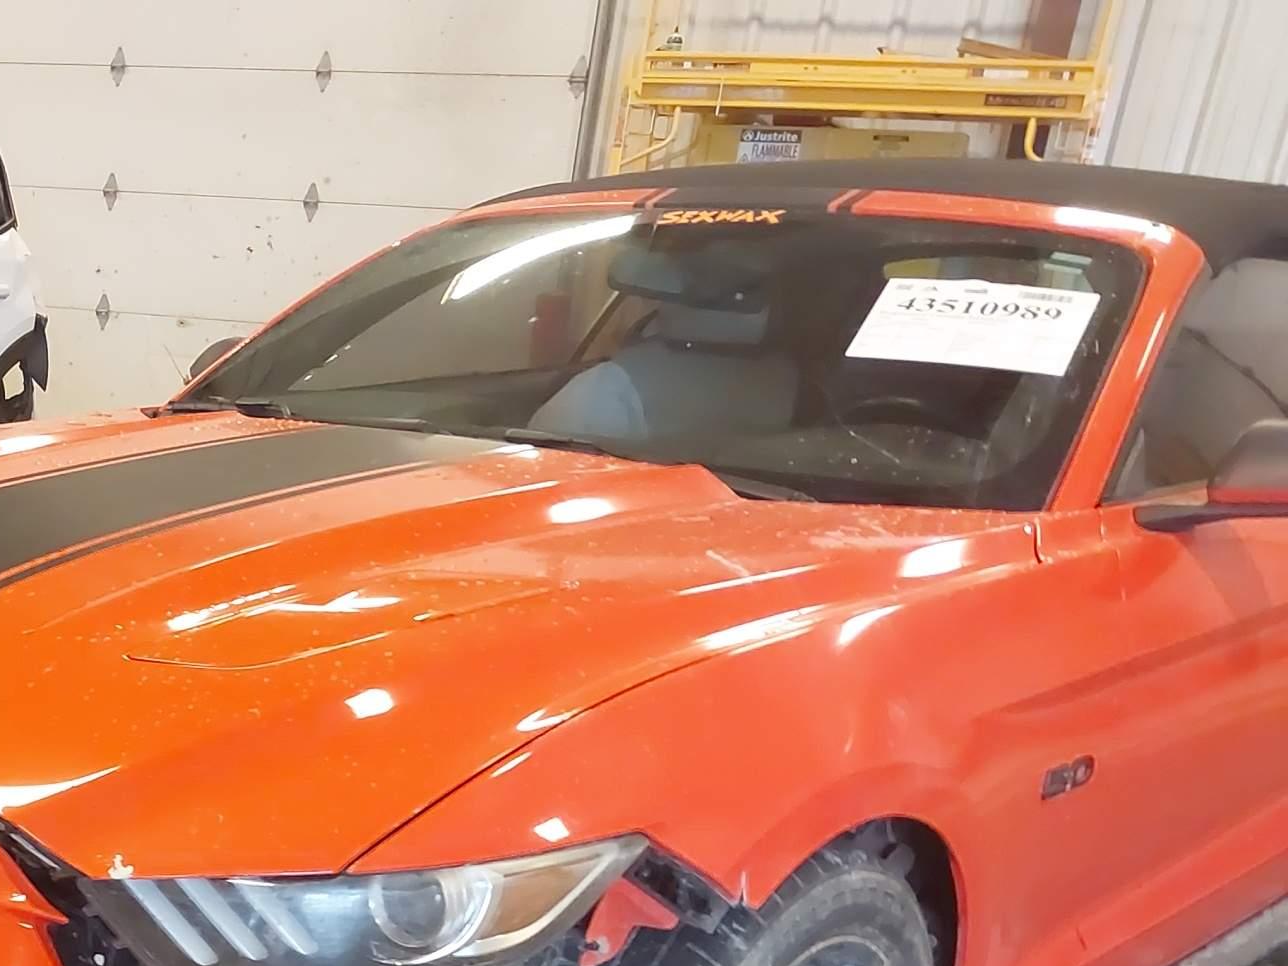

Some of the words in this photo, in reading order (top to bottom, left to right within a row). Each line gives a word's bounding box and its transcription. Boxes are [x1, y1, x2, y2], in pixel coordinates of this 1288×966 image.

[754, 131, 799, 142] Justrite
[656, 209, 787, 225] SEXWAX
[897, 297, 1063, 321] 43510989
